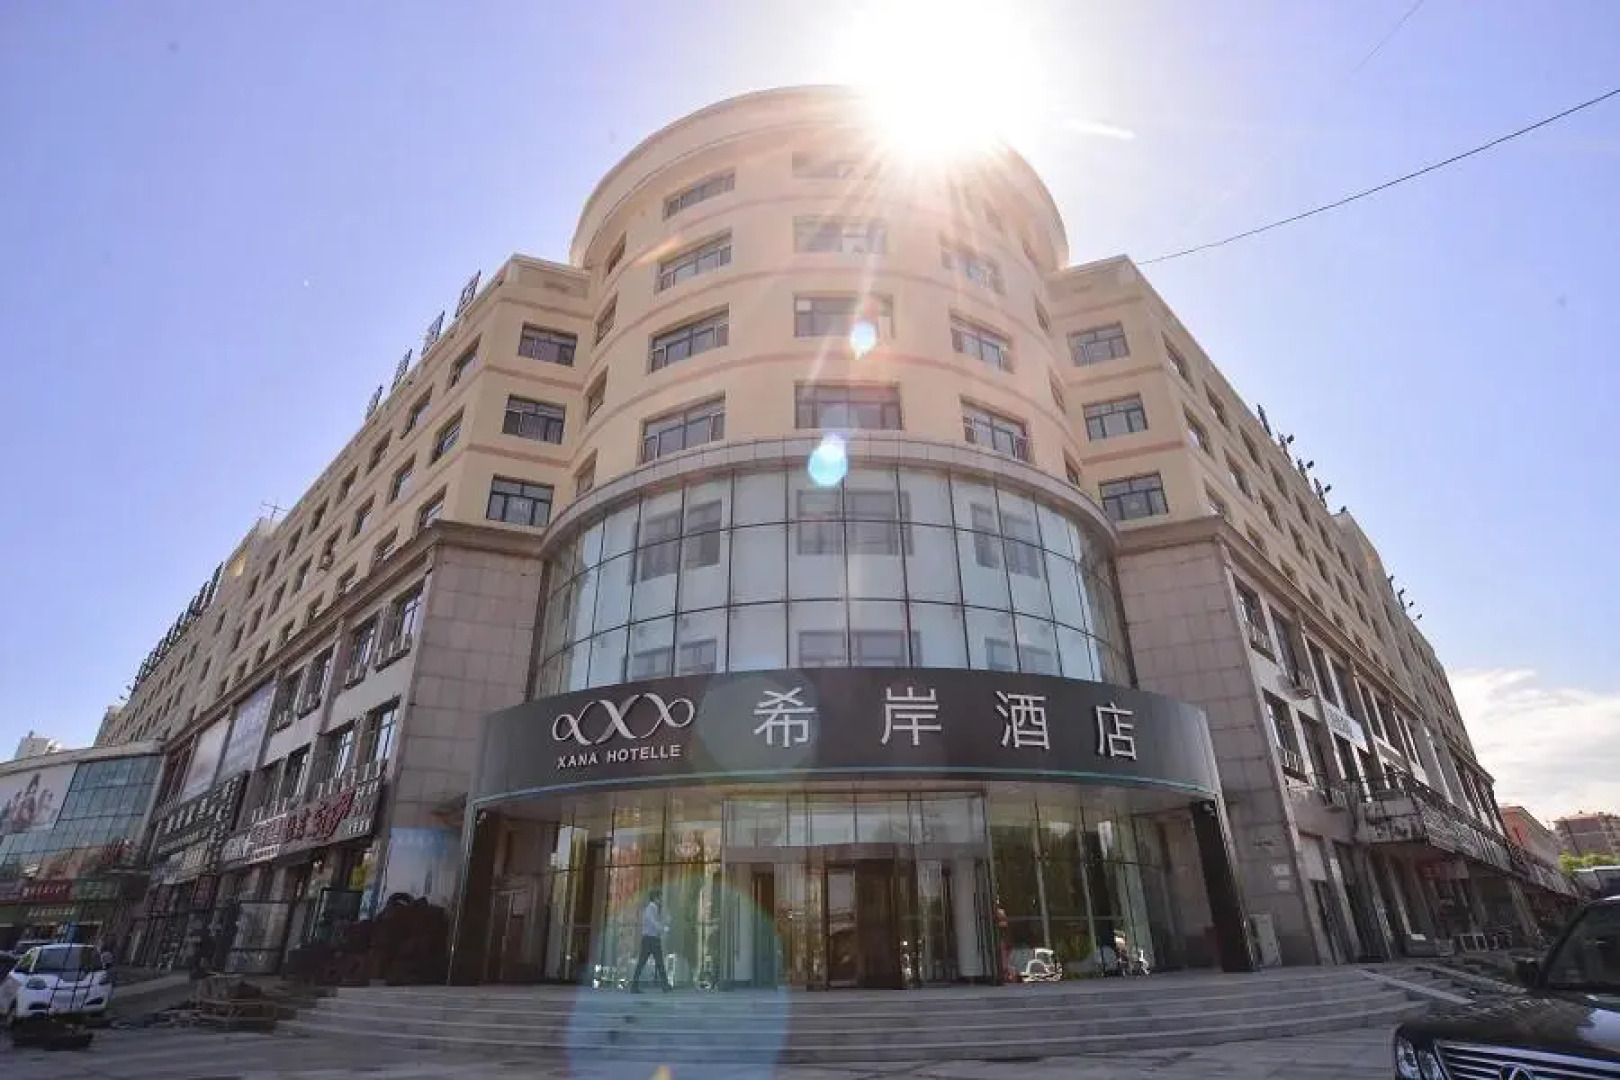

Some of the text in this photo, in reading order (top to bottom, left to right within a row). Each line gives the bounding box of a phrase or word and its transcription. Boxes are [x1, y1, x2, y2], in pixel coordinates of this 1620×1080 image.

[753, 686, 1138, 760] 希岸酒店
[557, 744, 681, 769] XANA HOTELLE
